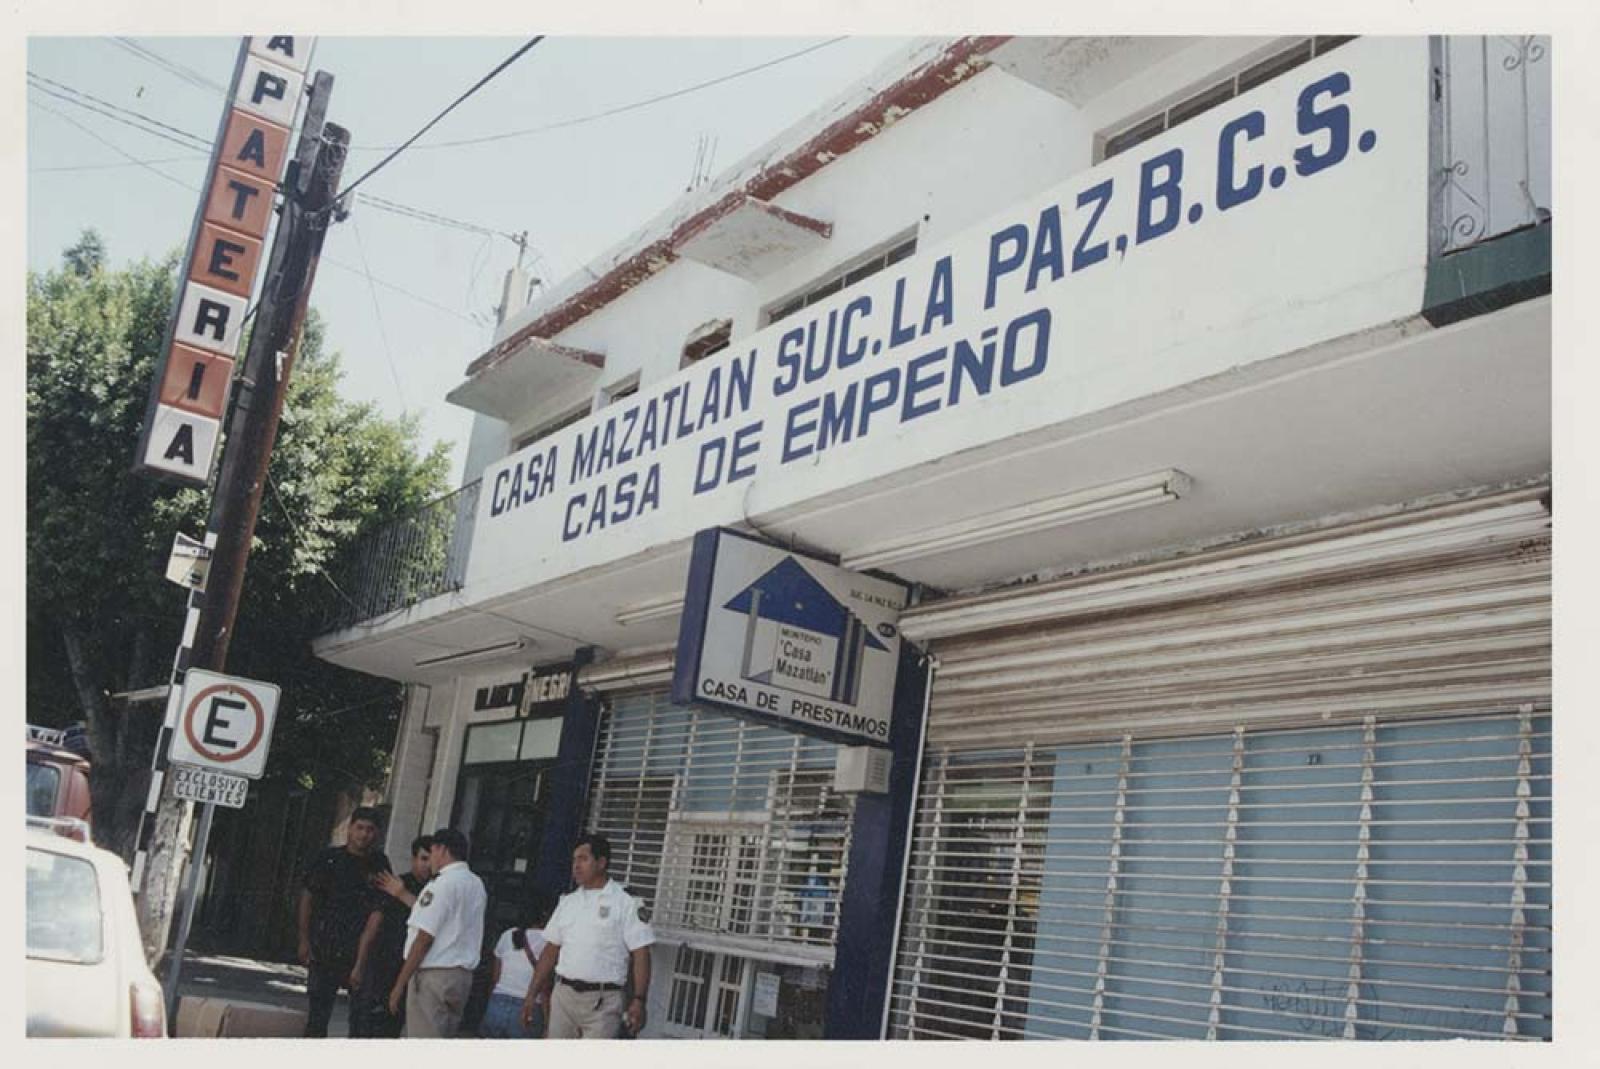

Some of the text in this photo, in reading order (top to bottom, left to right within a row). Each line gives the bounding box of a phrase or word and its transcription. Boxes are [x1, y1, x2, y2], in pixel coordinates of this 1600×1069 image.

[489, 445, 557, 518] CASA
[569, 349, 757, 484] MAZATLAN
[561, 308, 1052, 542] CASA DE EMPEÑO
[203, 696, 247, 749] E
[702, 678, 889, 737] CASA DE PRESTAMOS
[176, 782, 244, 804] CLIENTES
